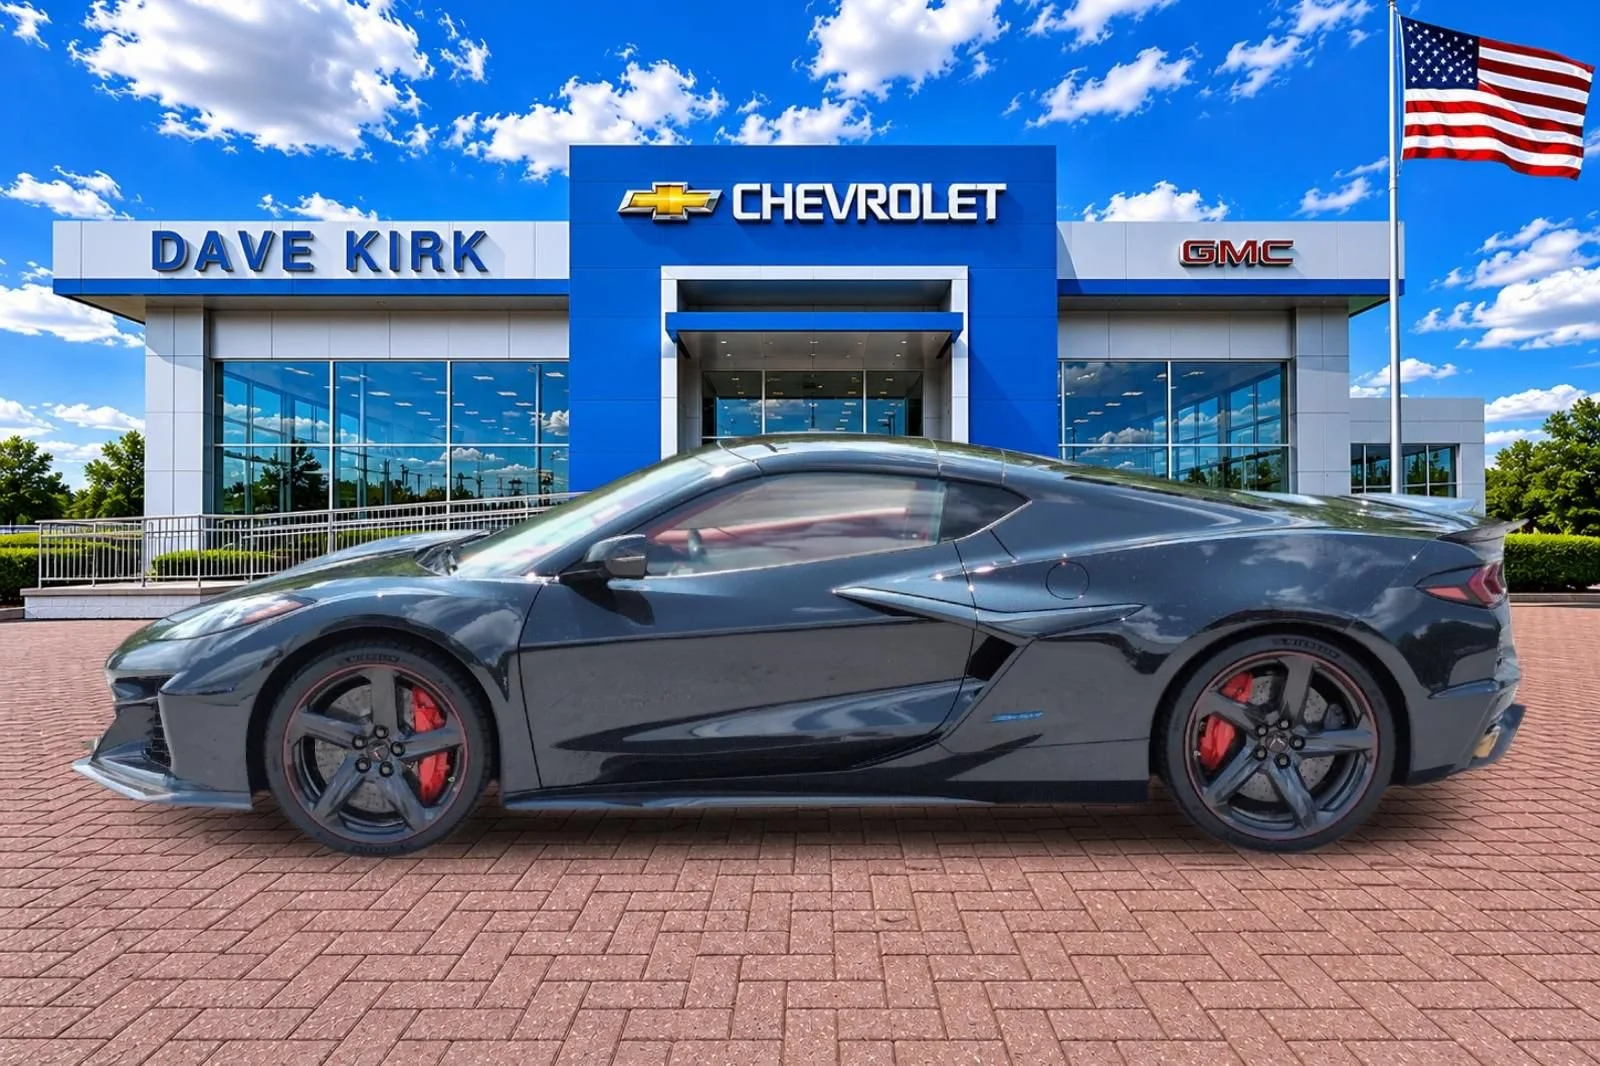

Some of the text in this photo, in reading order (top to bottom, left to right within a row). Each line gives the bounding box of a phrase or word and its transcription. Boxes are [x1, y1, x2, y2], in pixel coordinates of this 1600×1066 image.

[733, 183, 1007, 221] CHEVROLET
[151, 230, 489, 272] DAVE KIRK
[1179, 239, 1295, 267] GMC
